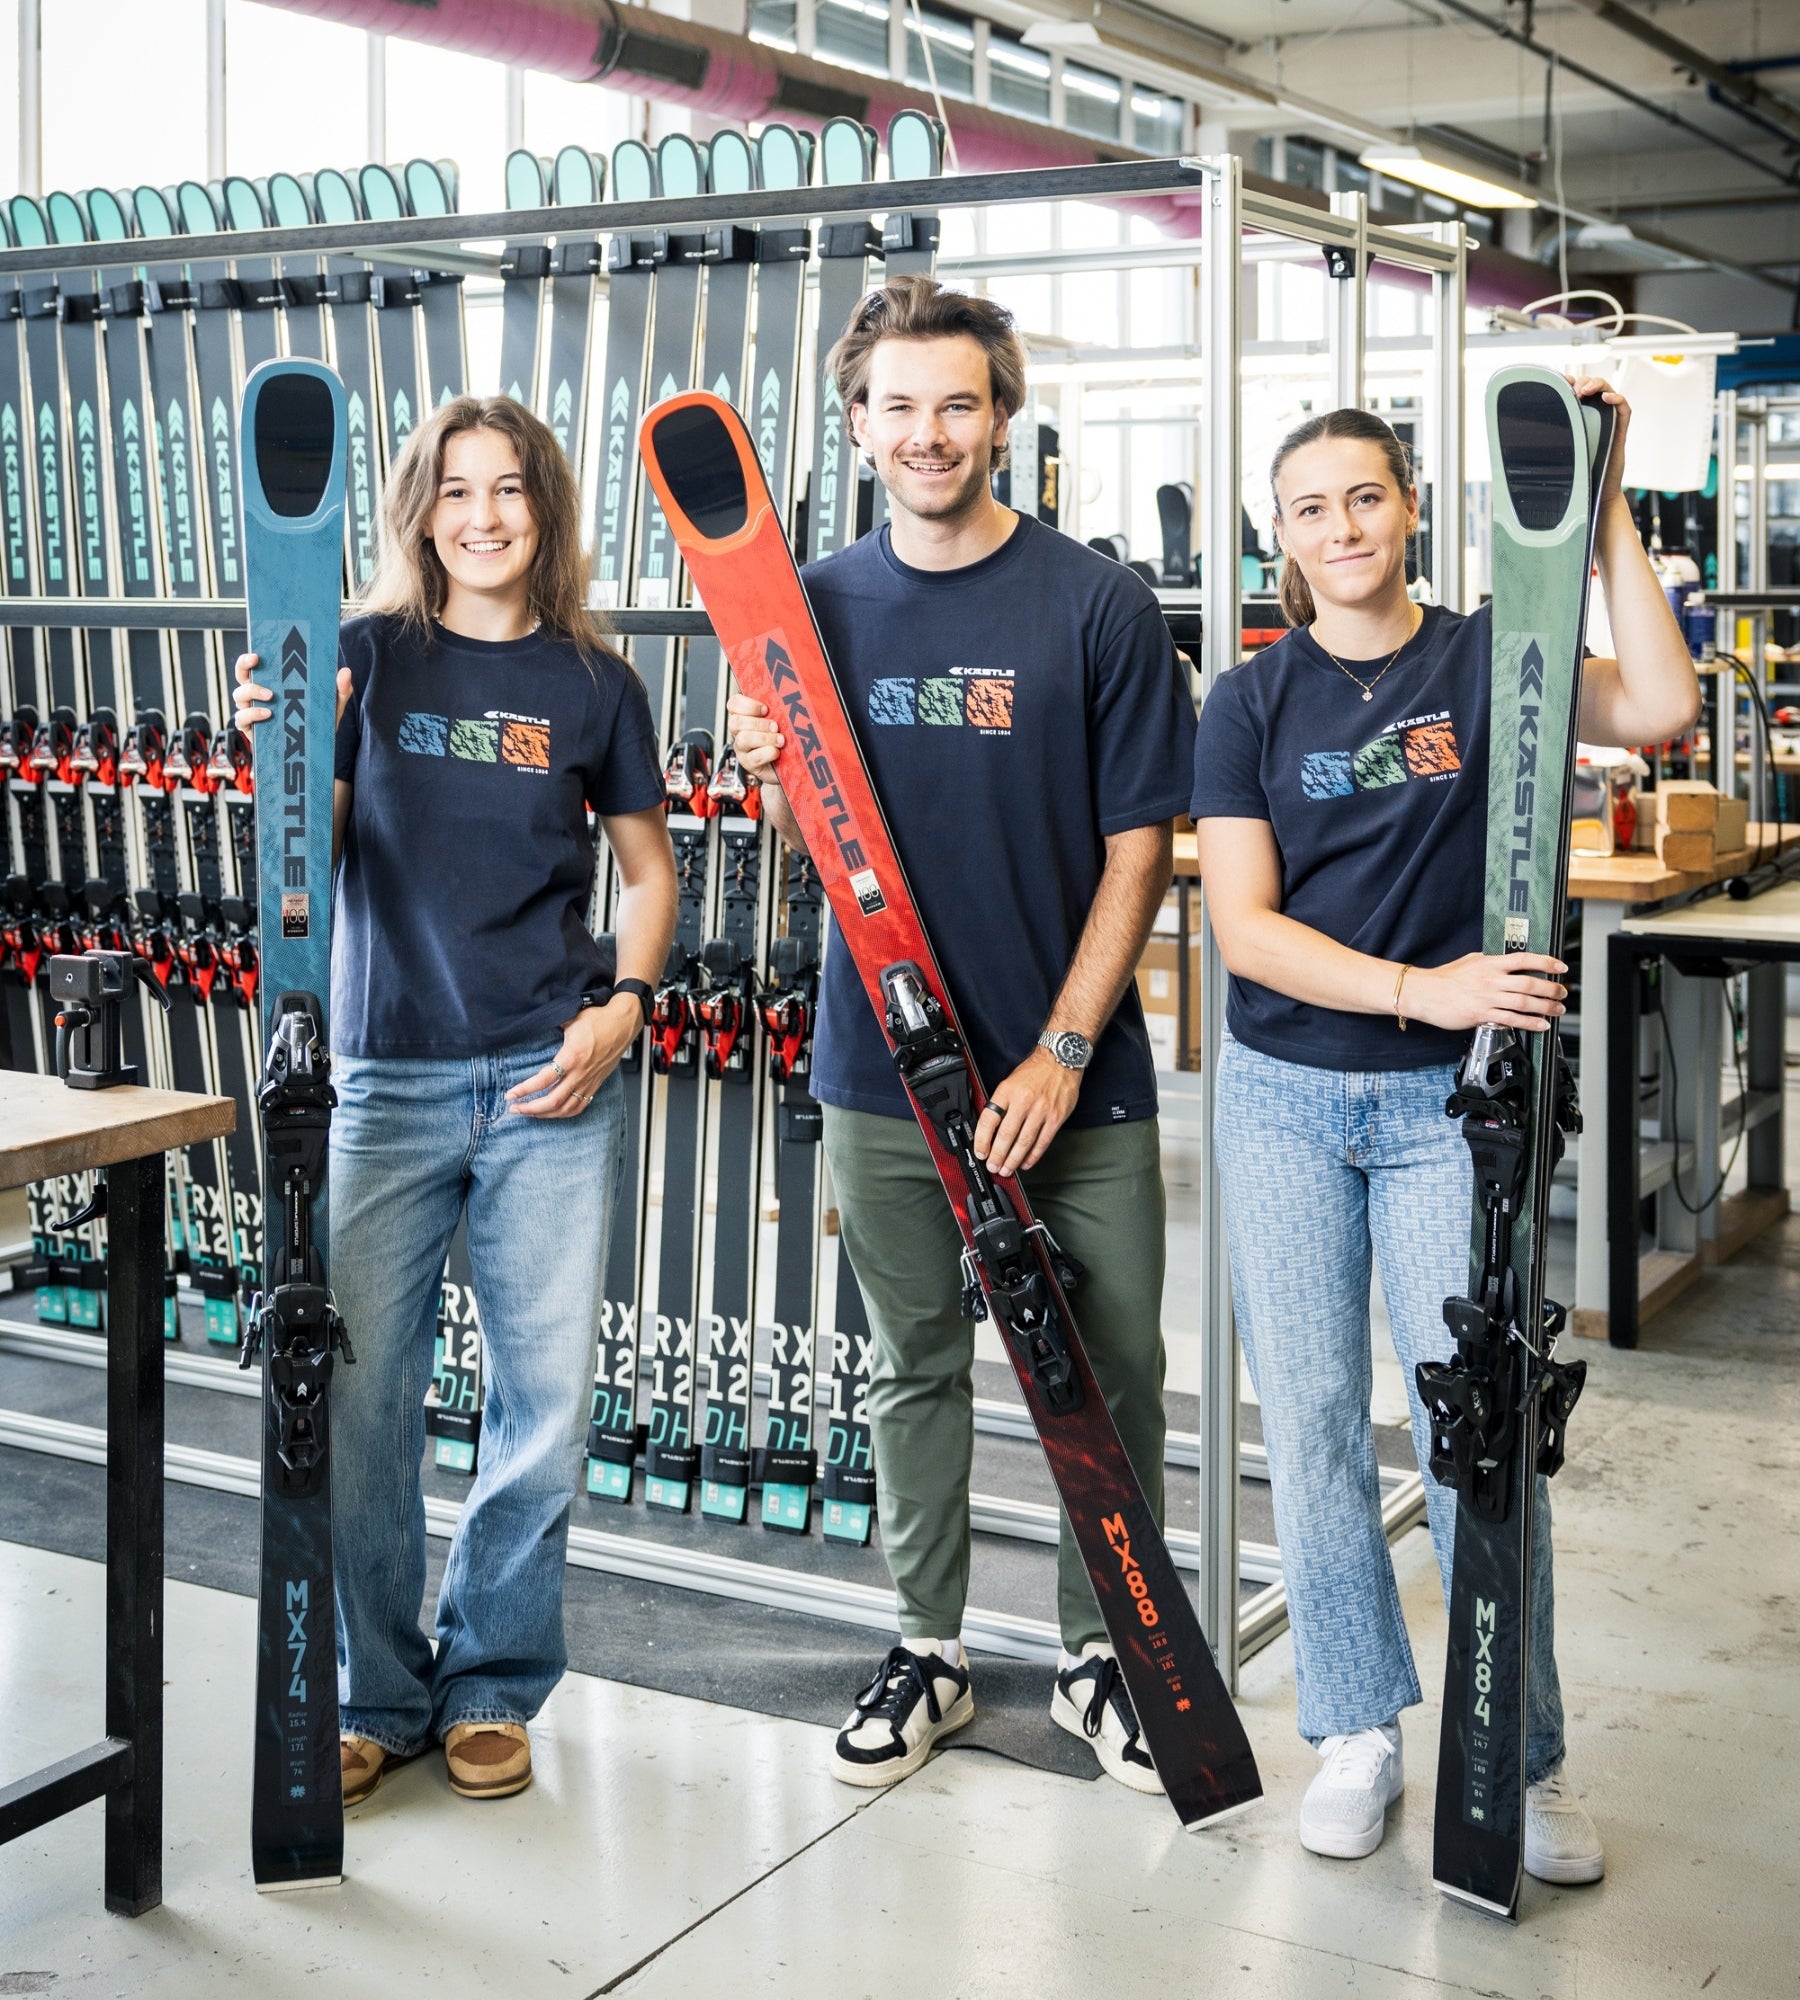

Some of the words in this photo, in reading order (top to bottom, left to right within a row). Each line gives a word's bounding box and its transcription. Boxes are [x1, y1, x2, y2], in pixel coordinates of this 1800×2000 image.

[1430, 774, 1448, 783] SINCE
[192, 1184, 222, 1218] RX
[195, 1220, 228, 1255] 12
[442, 1326, 478, 1371] 12
[655, 1313, 691, 1359] RX
[710, 1313, 748, 1359] RX
[772, 1322, 811, 1368] RX
[831, 1331, 873, 1377] RX
[594, 1343, 633, 1389] 12
[651, 1360, 690, 1405] 12
[706, 1359, 747, 1405] 12
[440, 1371, 475, 1412] DH
[591, 1389, 631, 1431] DH
[768, 1368, 810, 1415] 12
[649, 1406, 688, 1449] DH
[704, 1406, 746, 1450] DH
[826, 1426, 871, 1470] DH
[1100, 1511, 1159, 1627] MX88
[286, 1579, 308, 1703] MX74
[1473, 1597, 1496, 1727] MX84
